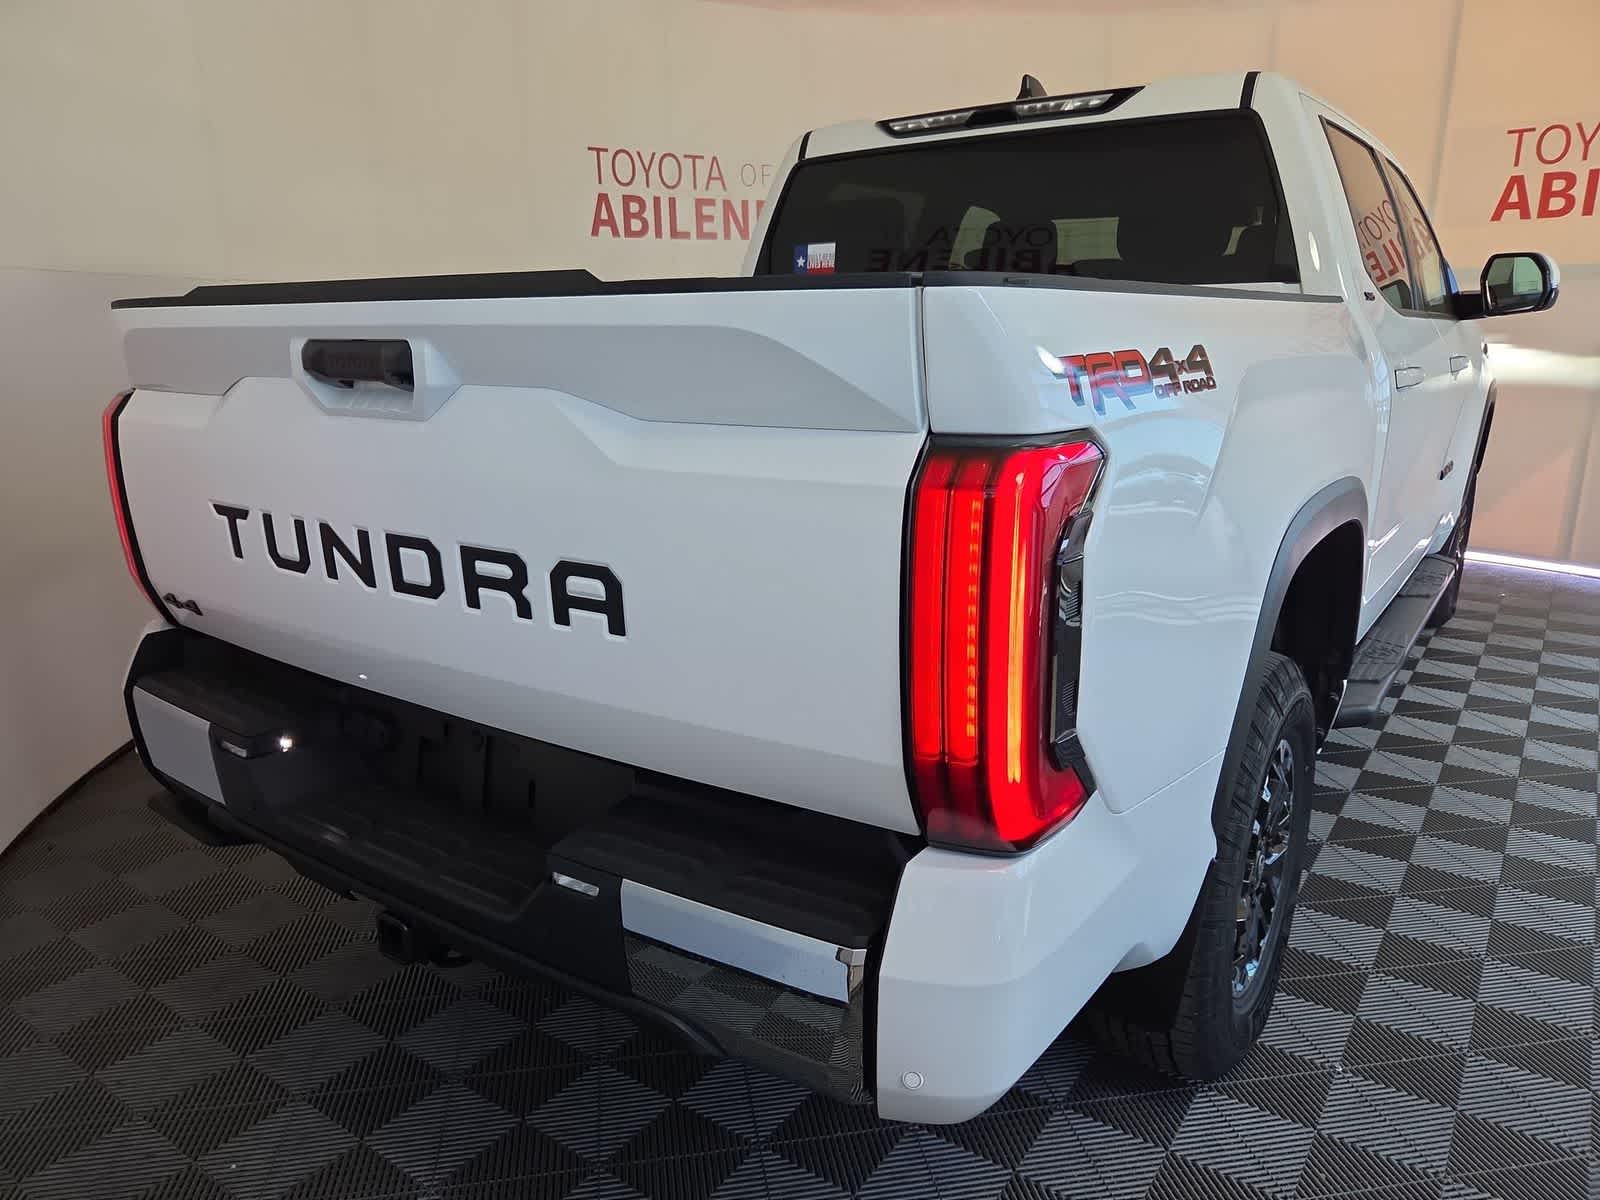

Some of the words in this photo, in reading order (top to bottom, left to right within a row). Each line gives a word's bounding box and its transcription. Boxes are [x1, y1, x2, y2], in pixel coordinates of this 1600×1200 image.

[587, 146, 728, 192] TOYOTA
[1056, 349, 1152, 416] TRD
[1154, 382, 1182, 400] OFF
[1183, 376, 1217, 394] ROAD
[212, 503, 627, 638] TUNDRA
